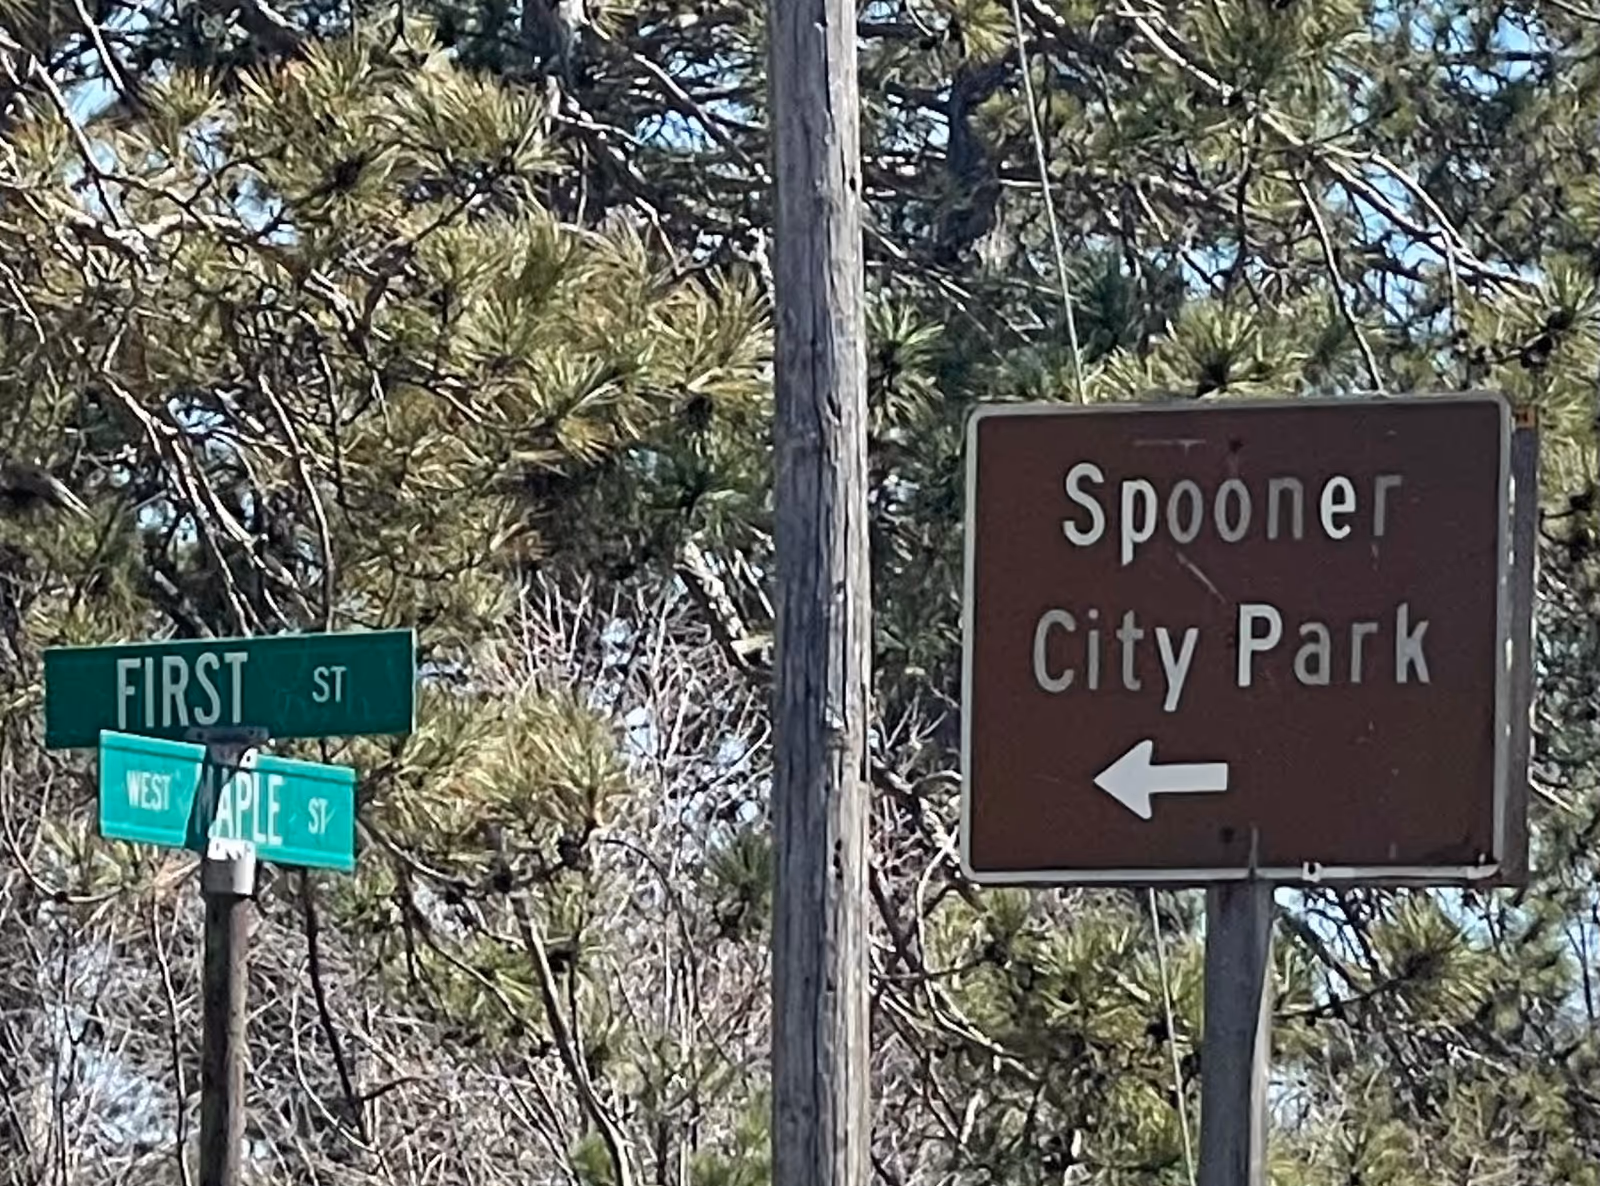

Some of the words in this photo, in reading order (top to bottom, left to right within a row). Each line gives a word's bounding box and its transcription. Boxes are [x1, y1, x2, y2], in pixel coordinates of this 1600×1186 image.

[1062, 462, 1404, 566] Spooner
[116, 652, 248, 730] FIRST
[312, 666, 347, 704] ST
[1033, 608, 1199, 712] City
[1237, 602, 1431, 688] Park
[126, 769, 172, 810] WEST
[307, 797, 331, 835] ST
